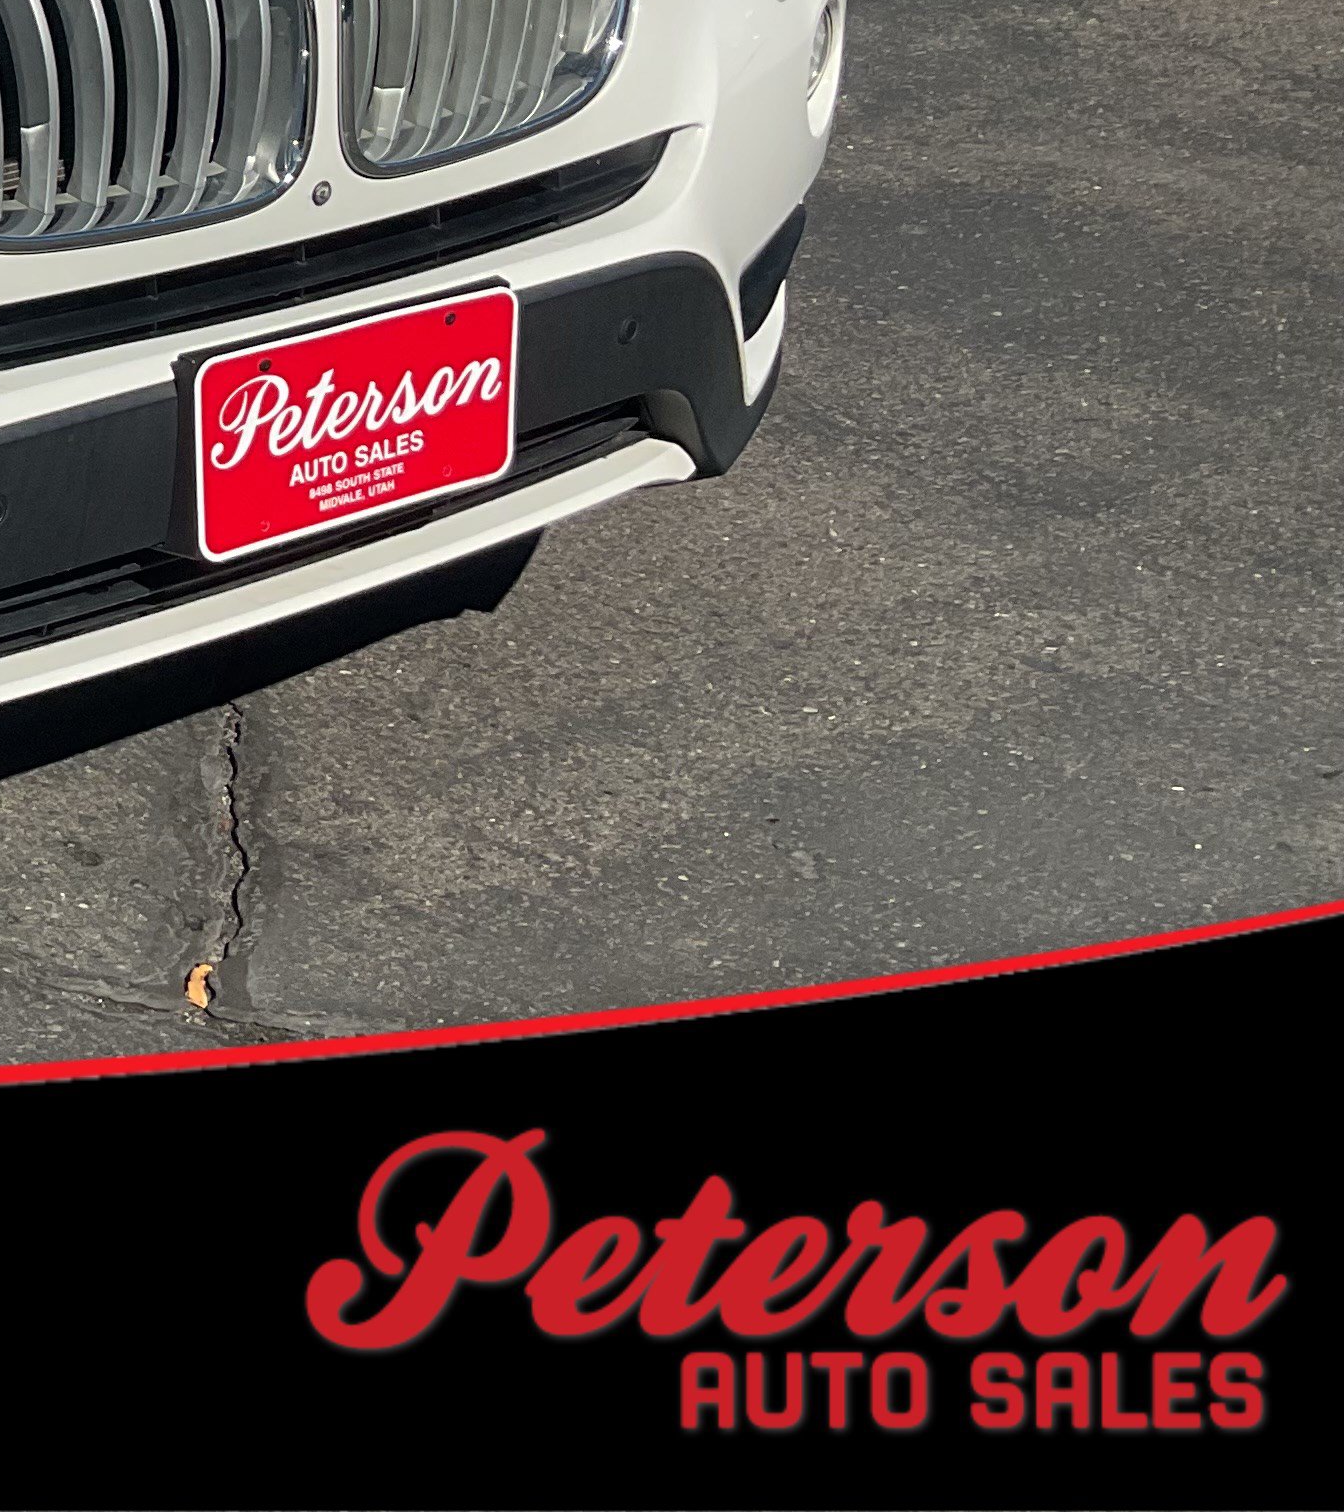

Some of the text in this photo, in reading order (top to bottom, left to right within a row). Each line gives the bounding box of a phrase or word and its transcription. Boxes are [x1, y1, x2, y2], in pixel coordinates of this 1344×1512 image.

[211, 356, 502, 470] Peterson
[289, 429, 425, 487] AUTO SALES
[335, 472, 372, 492] SOUTH
[373, 462, 405, 481] STATE
[368, 480, 396, 497] UTAH
